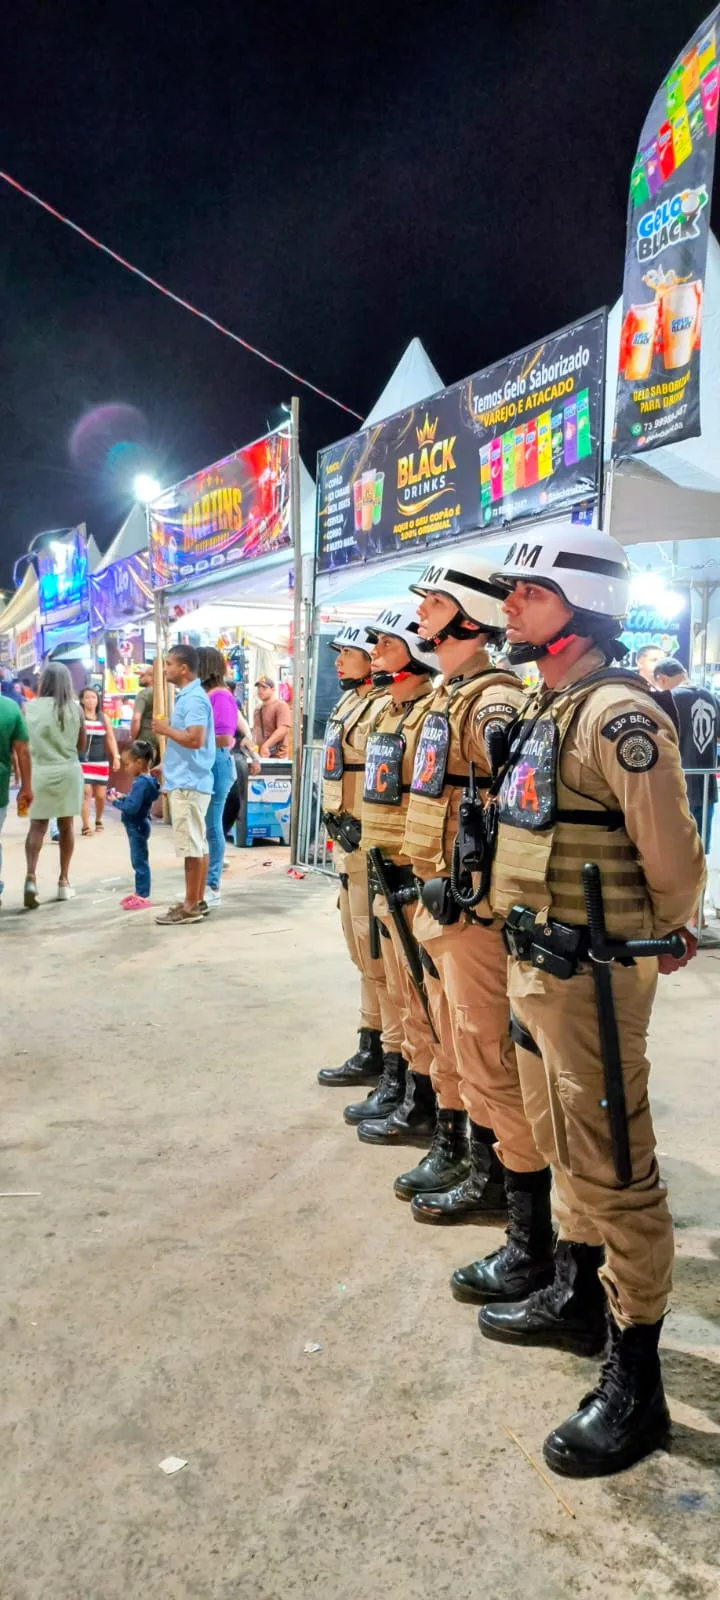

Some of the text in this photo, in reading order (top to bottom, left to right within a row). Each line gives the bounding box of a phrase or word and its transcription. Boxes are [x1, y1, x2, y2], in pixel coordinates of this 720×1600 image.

[637, 213, 700, 262] BLACK
[473, 344, 590, 414] Temos Gelo Saborizado
[483, 402, 516, 428] VAREJO
[517, 399, 524, 414] E
[525, 377, 574, 411] ATACADO
[640, 399, 661, 414] PARA
[397, 435, 457, 489] BLACK
[404, 475, 446, 501] DRINKS
[182, 486, 242, 539] MARTINS
[393, 521, 408, 534] AQUI
[408, 519, 415, 529] O
[415, 514, 429, 527] SEU
[429, 507, 454, 523] COPÃO
[489, 703, 513, 714] BEIC
[629, 714, 652, 727] BEIC
[376, 763, 390, 793] C
[520, 767, 538, 813] A
